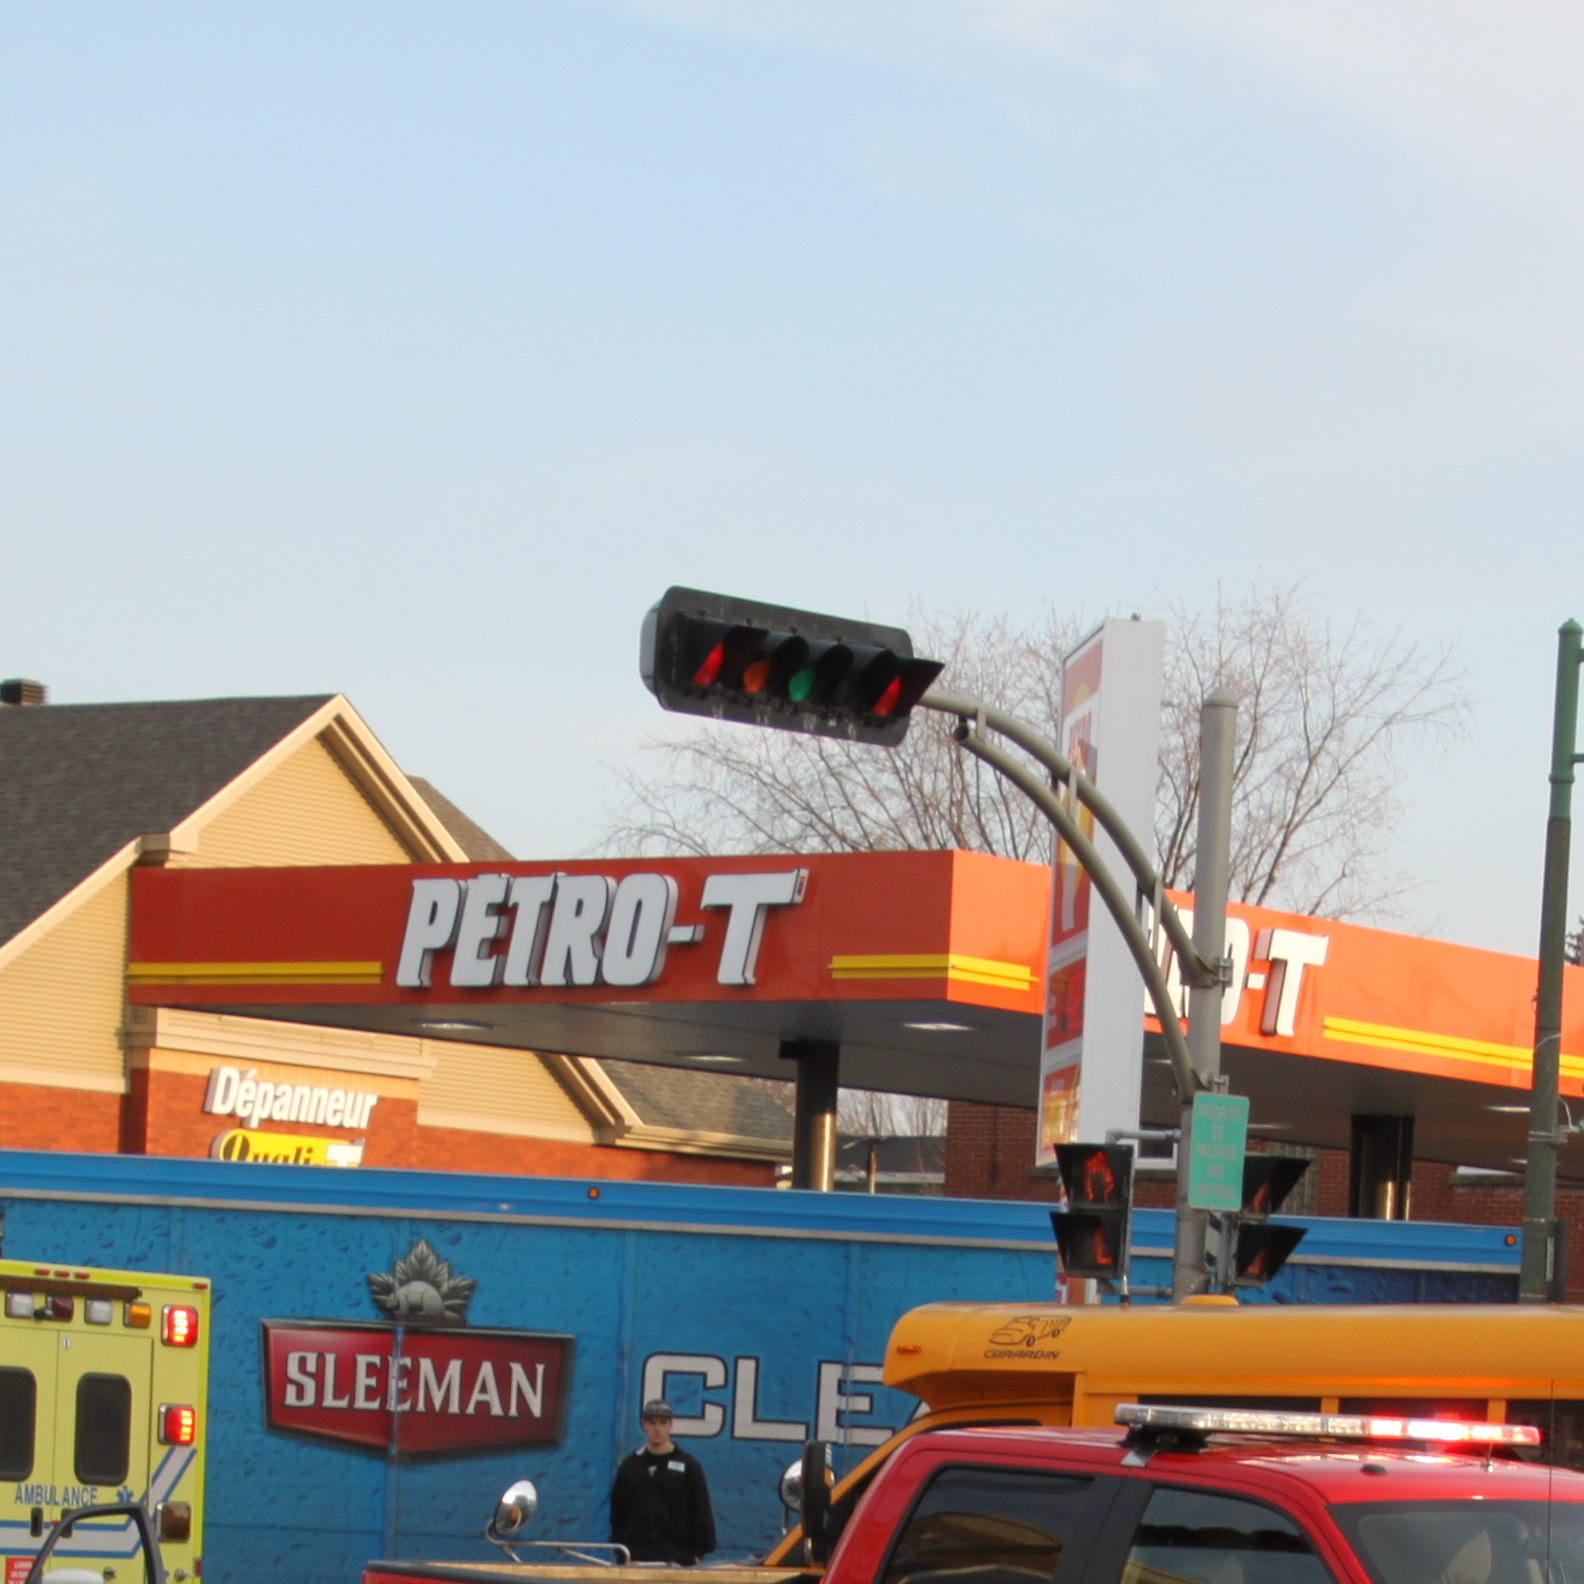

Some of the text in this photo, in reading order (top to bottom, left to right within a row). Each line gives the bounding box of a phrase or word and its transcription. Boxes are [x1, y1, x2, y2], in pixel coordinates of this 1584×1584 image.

[211, 1066, 380, 1130] Dépanneur
[284, 1351, 546, 1418] SLEEMAN
[983, 1350, 1061, 1360] GIRARDIN
[641, 1352, 916, 1447] CLE
[14, 1483, 98, 1507] AMBULANCE
